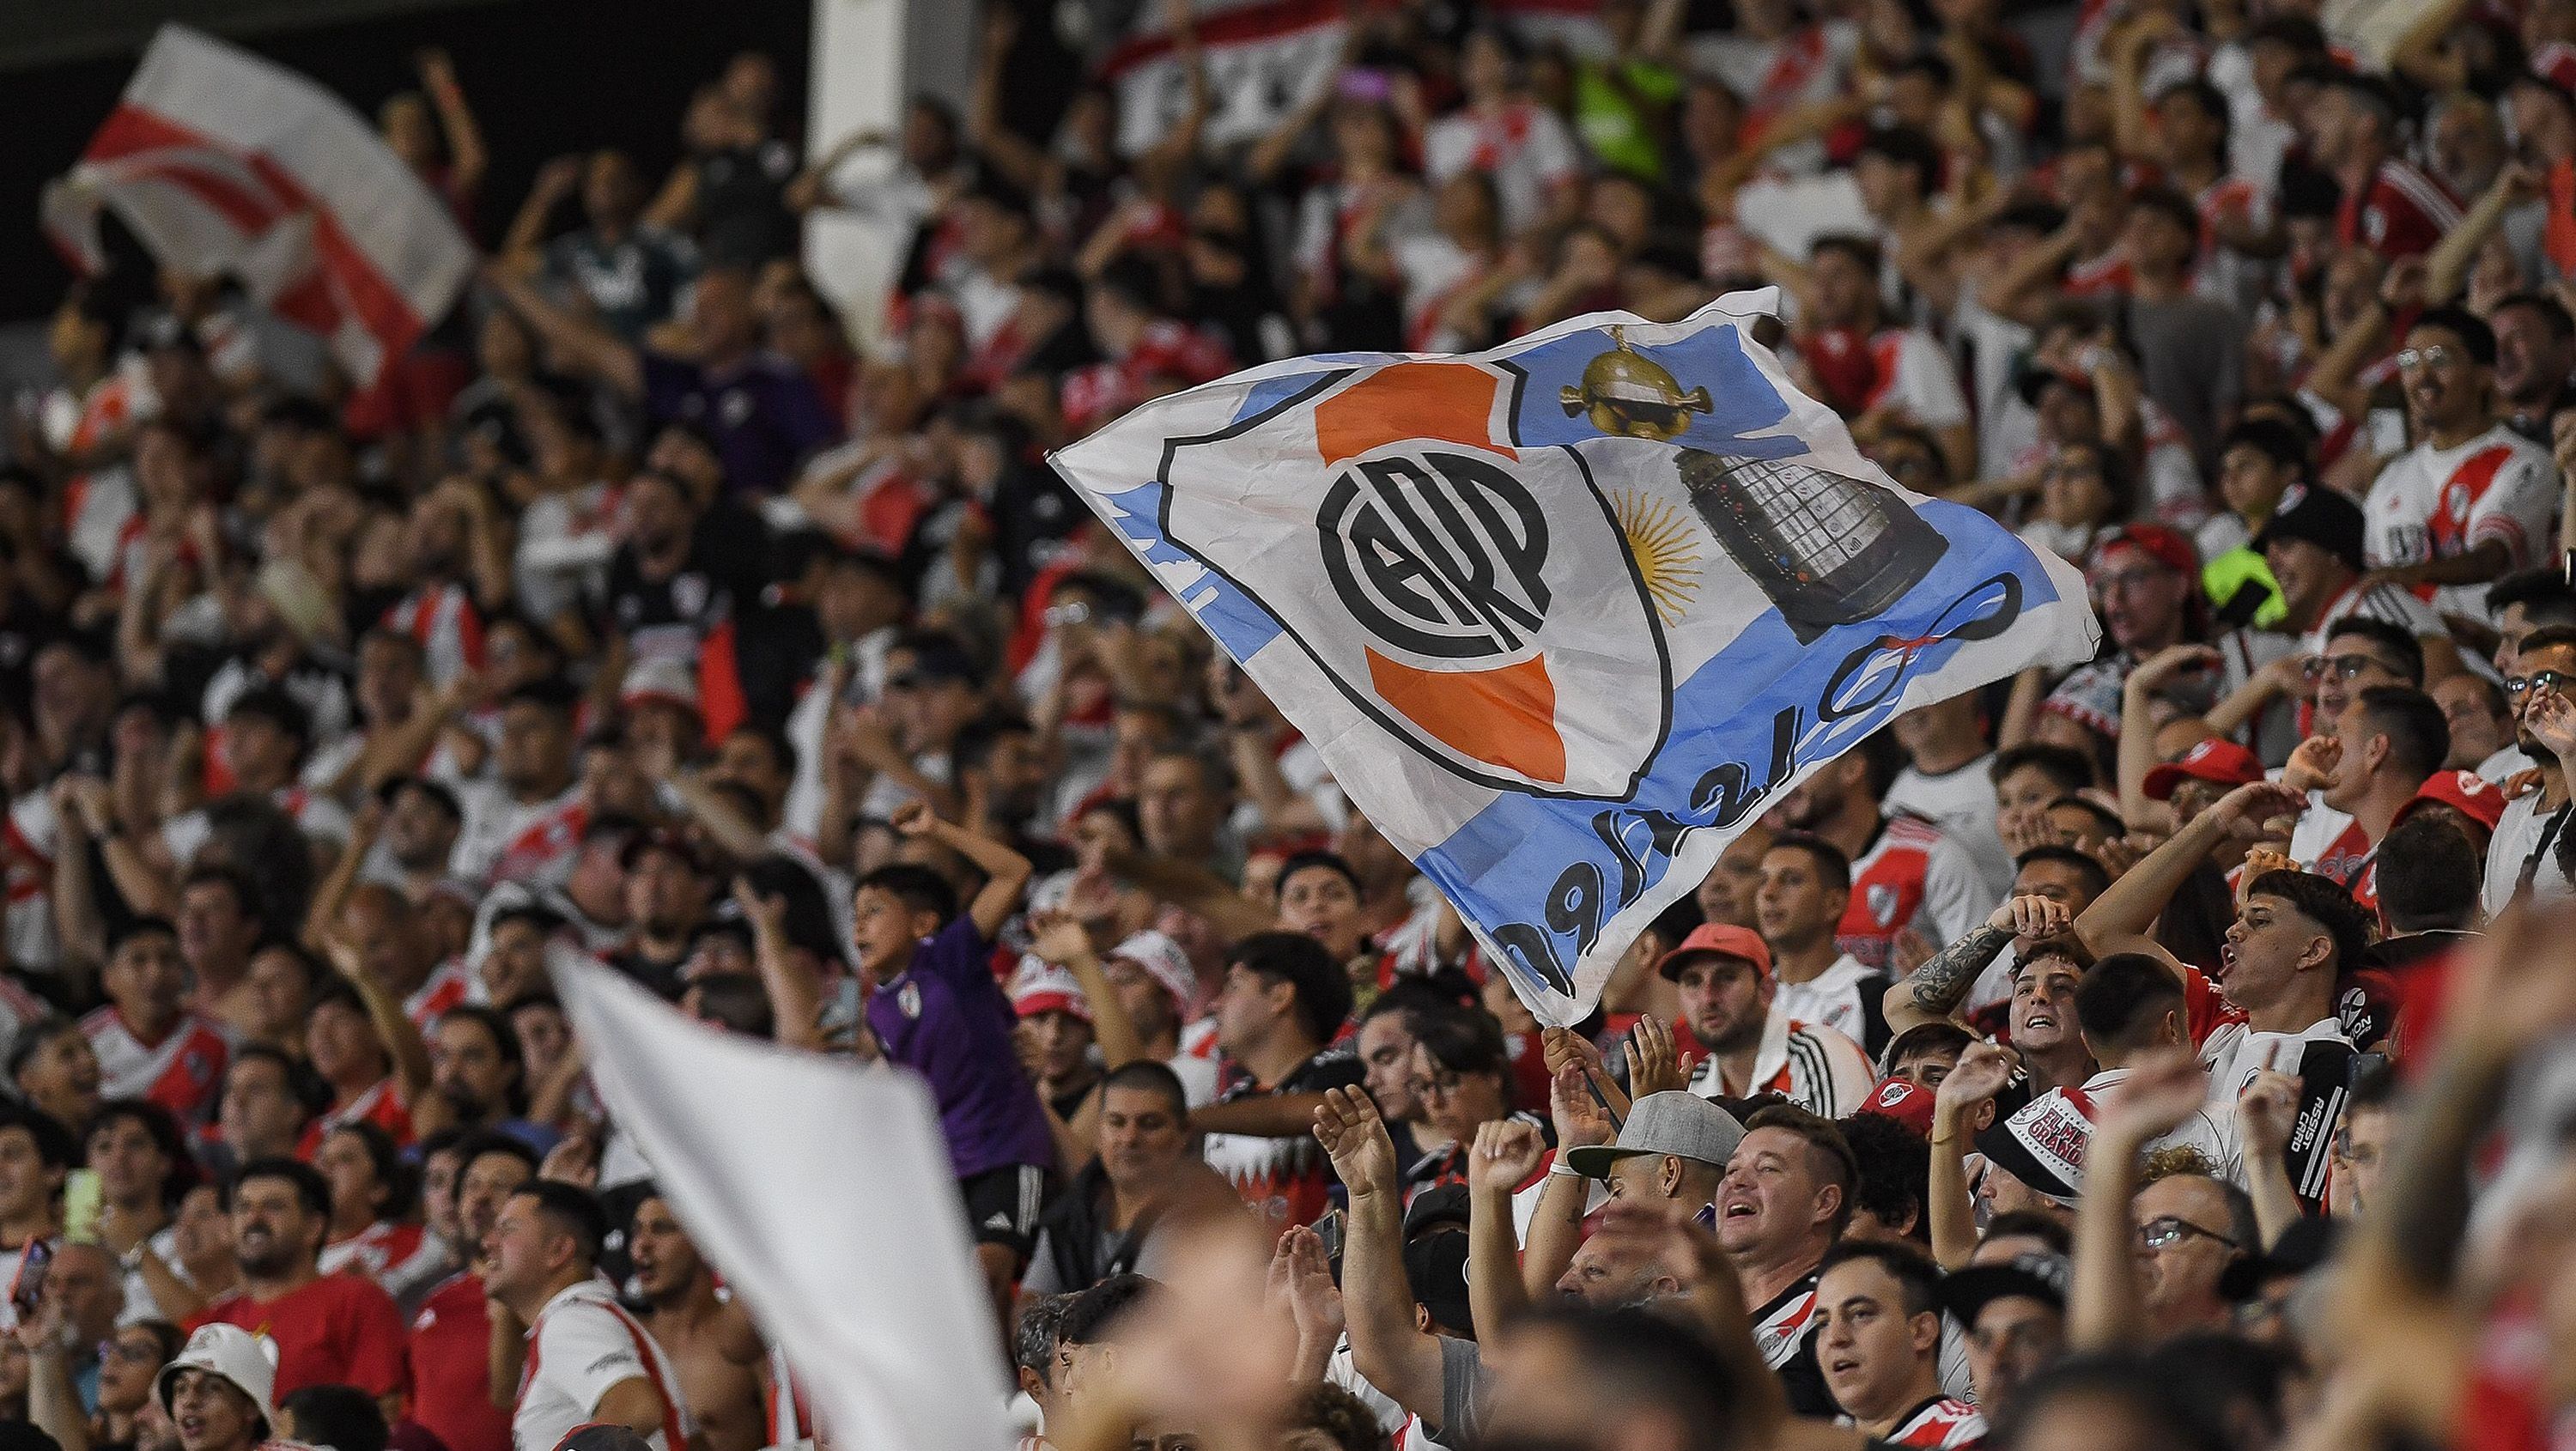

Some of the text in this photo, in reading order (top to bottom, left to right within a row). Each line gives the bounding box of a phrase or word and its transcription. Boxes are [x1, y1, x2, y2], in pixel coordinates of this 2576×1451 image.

[2028, 1120, 2084, 1166] GRAND
[2042, 1108, 2089, 1149] EL MA
[2291, 1111, 2310, 1152] CARD
[2302, 1096, 2324, 1150] ASSIST
